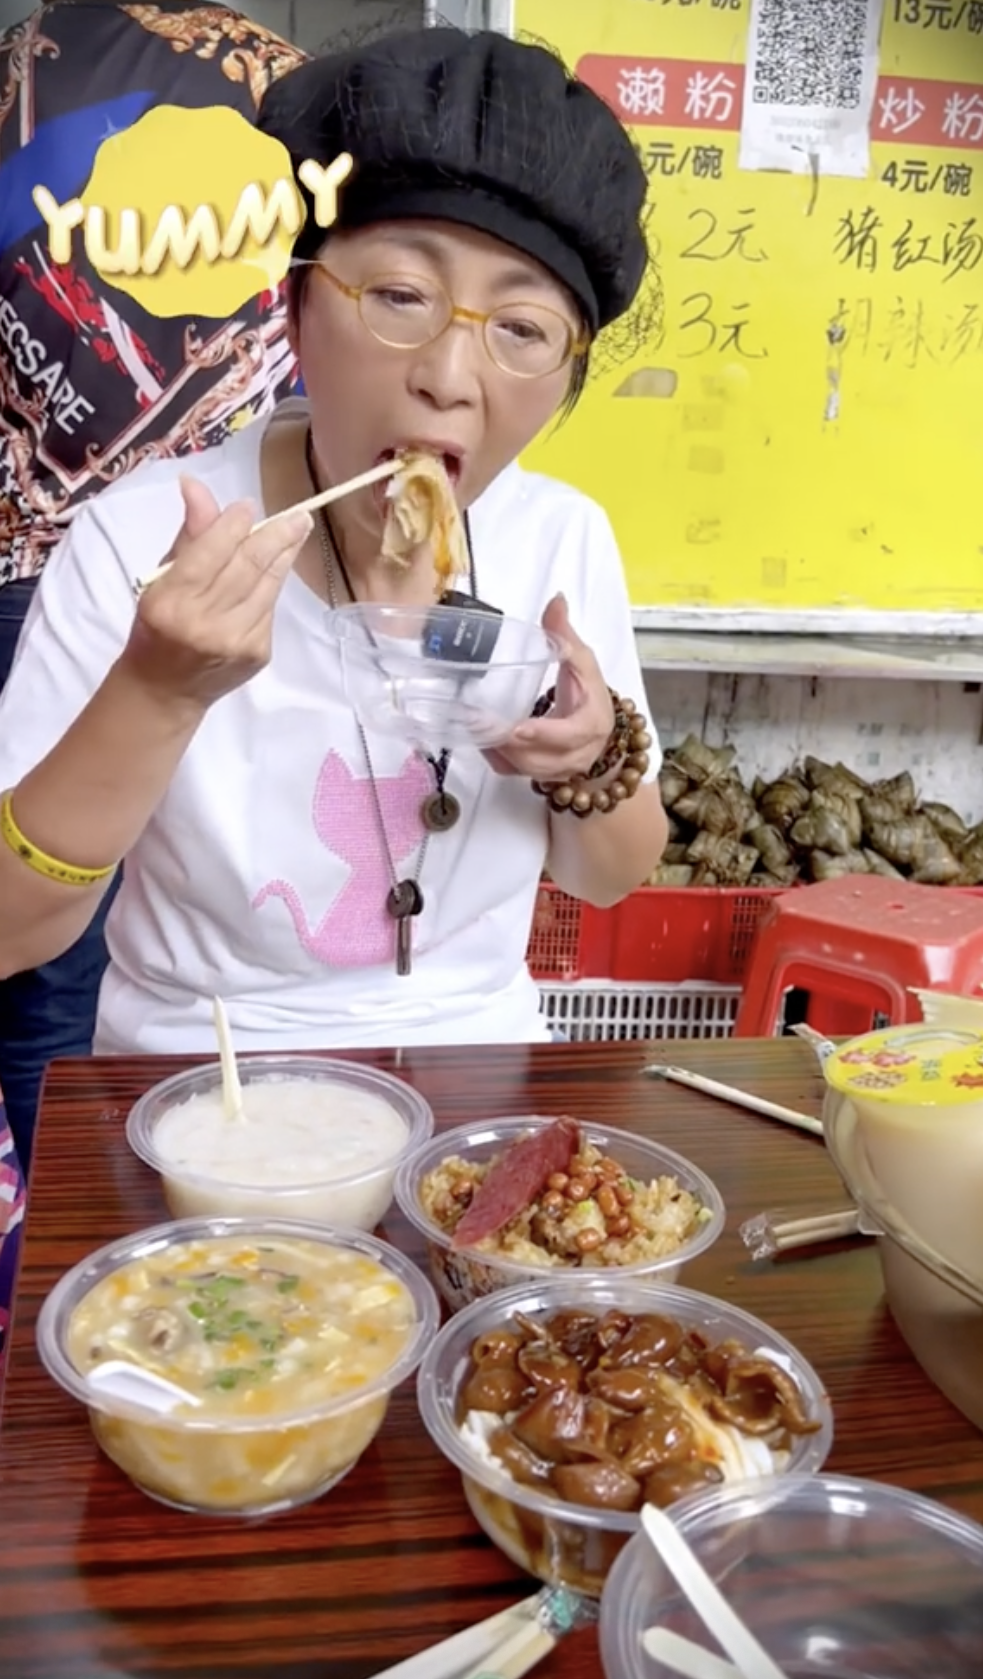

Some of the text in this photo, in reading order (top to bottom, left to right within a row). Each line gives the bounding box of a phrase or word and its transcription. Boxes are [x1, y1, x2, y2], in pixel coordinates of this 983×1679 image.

[878, 86, 983, 140] 炒粉
[642, 142, 723, 180] 元/碗
[881, 159, 973, 197] 4元/碗
[679, 207, 769, 262] 2元
[833, 205, 983, 284] 猪红汤
[677, 291, 769, 359] 3元
